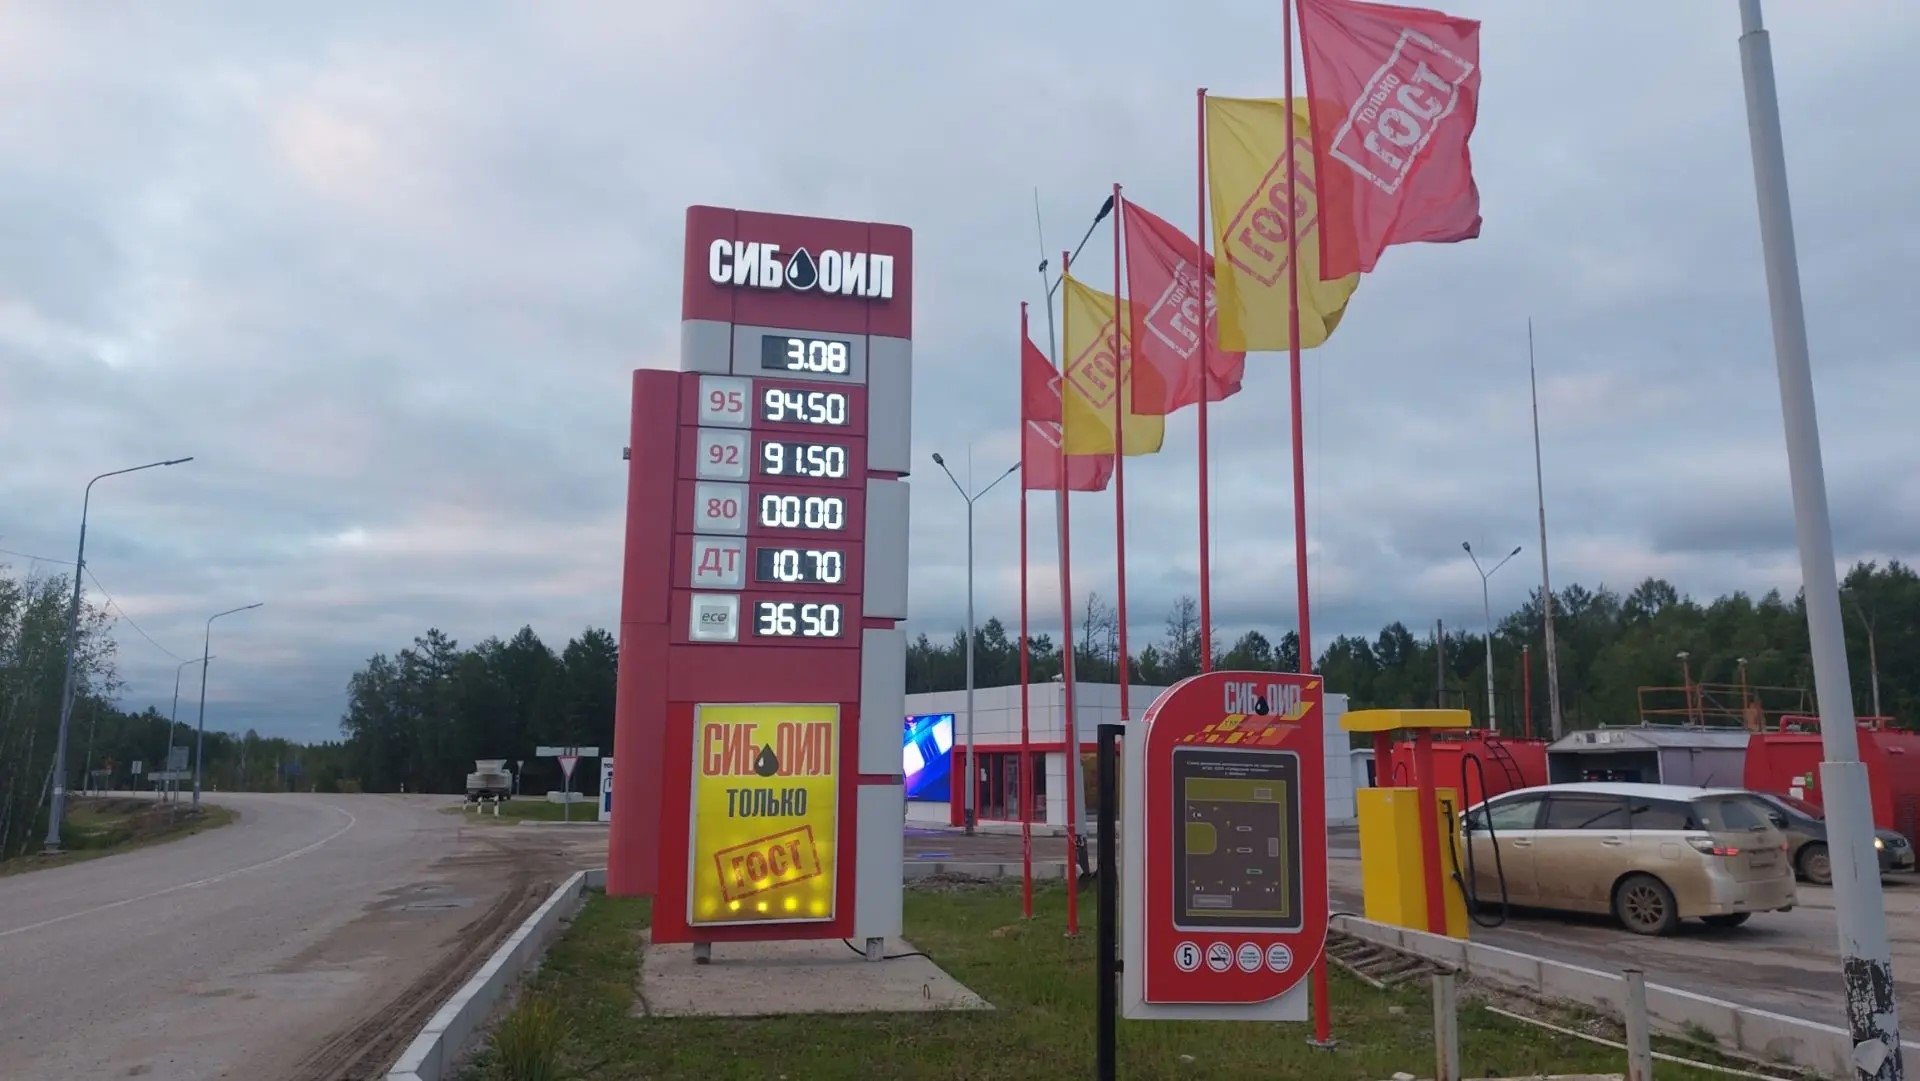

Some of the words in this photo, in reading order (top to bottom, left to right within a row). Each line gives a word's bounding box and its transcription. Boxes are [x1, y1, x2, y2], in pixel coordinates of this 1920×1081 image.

[1364, 61, 1452, 170] ГОСТ
[787, 338, 846, 374] 3.08
[710, 390, 743, 413] 95
[765, 389, 845, 425] 94.50
[709, 444, 739, 466] 92
[707, 498, 738, 519] 80
[698, 547, 741, 577] ДТ
[773, 549, 841, 583] 10.70
[726, 787, 808, 818] ТОЛЬКО
[731, 839, 802, 888] ГОСТ
[1183, 947, 1192, 966] 5
